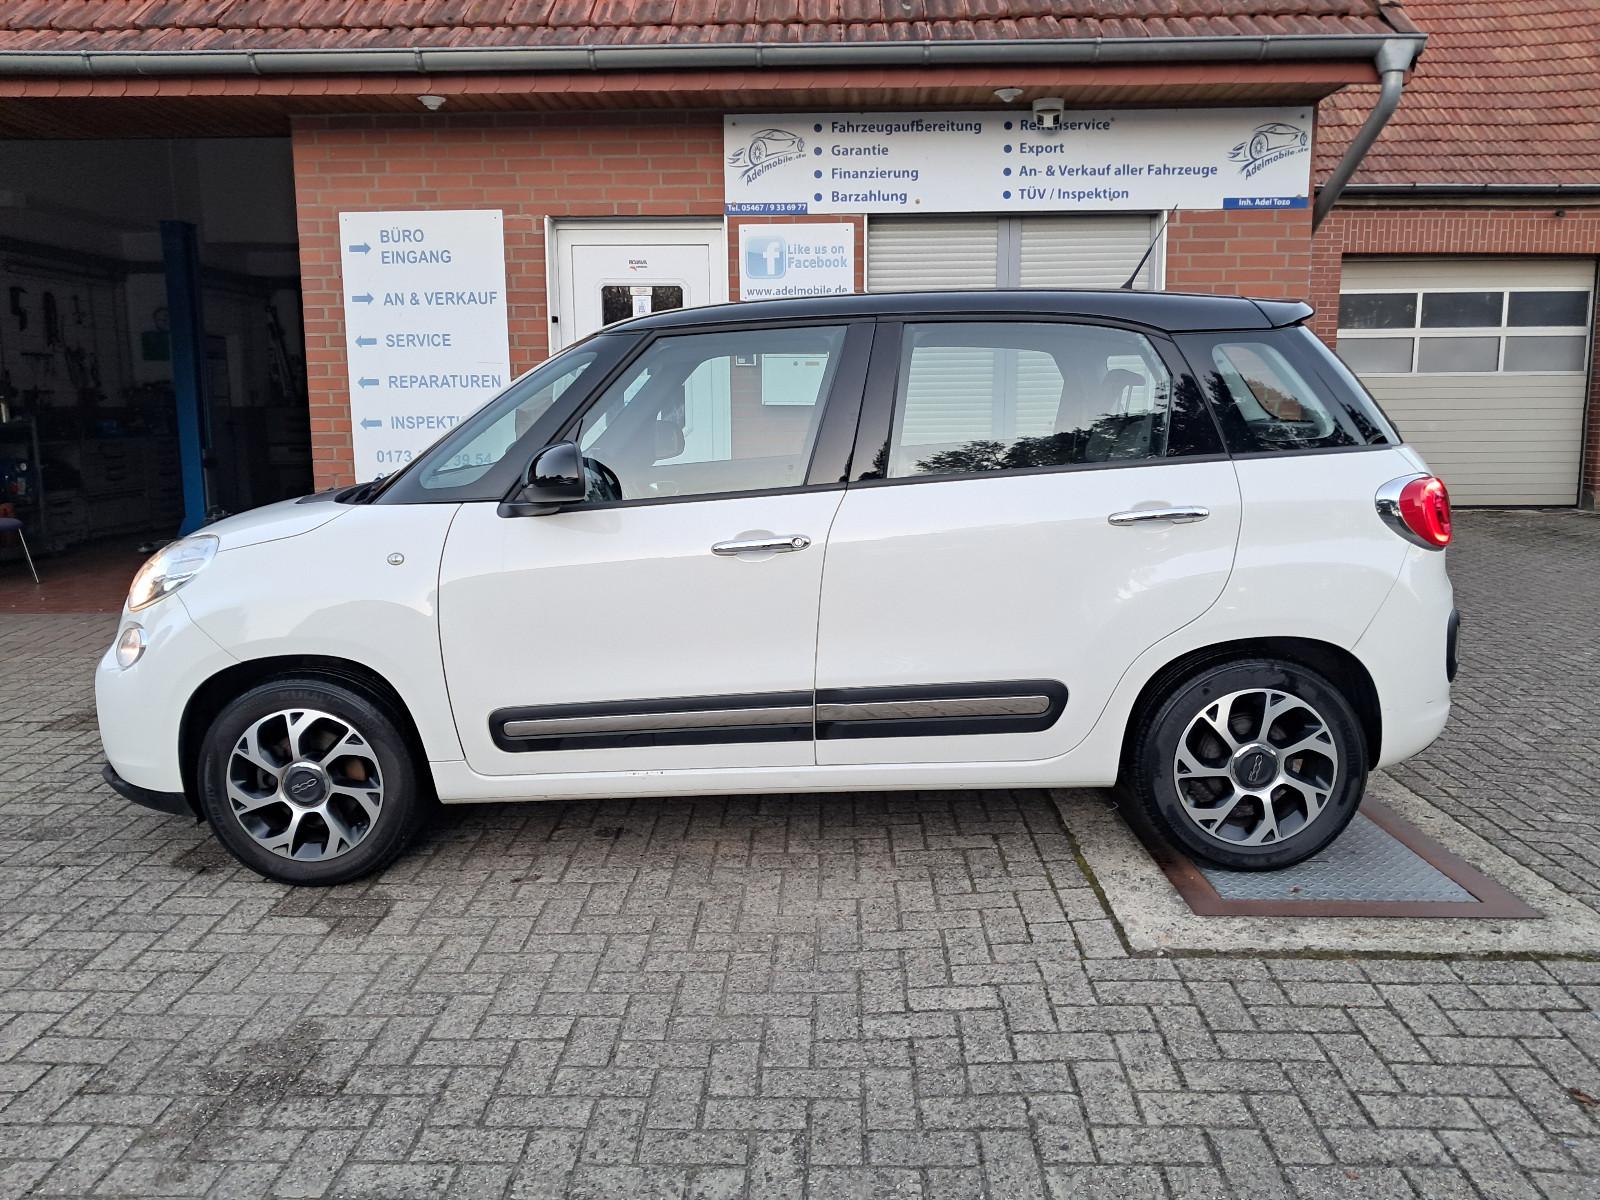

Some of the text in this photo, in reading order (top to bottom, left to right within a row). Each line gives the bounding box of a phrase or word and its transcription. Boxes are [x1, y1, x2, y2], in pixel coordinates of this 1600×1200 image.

[831, 120, 982, 136] Fahrzeugaufbereitung
[1020, 118, 1111, 131] Renservice
[831, 144, 889, 156] Garantie
[1019, 142, 1065, 156] Export
[745, 153, 807, 187] Adelmobile.de
[1019, 163, 1218, 179] An- & Verkauf aller Fahrzeuge
[1245, 147, 1309, 181] Adelmobile.de
[831, 166, 919, 182] Finanzierung
[831, 189, 908, 205] Barzahlung
[1018, 185, 1129, 202] TÜV / Inspektion
[786, 203, 796, 211] 69
[797, 203, 807, 211] 77
[1255, 198, 1272, 206] Adel
[379, 227, 424, 244] BÜRO
[381, 249, 452, 265] EINGANG
[787, 243, 845, 255] Like us on
[787, 255, 848, 269] Facebook
[383, 290, 498, 306] AN & VERKAUF
[746, 284, 848, 297] www.adelmobile.de
[385, 332, 452, 348] SERVICE
[388, 374, 502, 389] REPARATUREN
[376, 450, 413, 464] 0173
